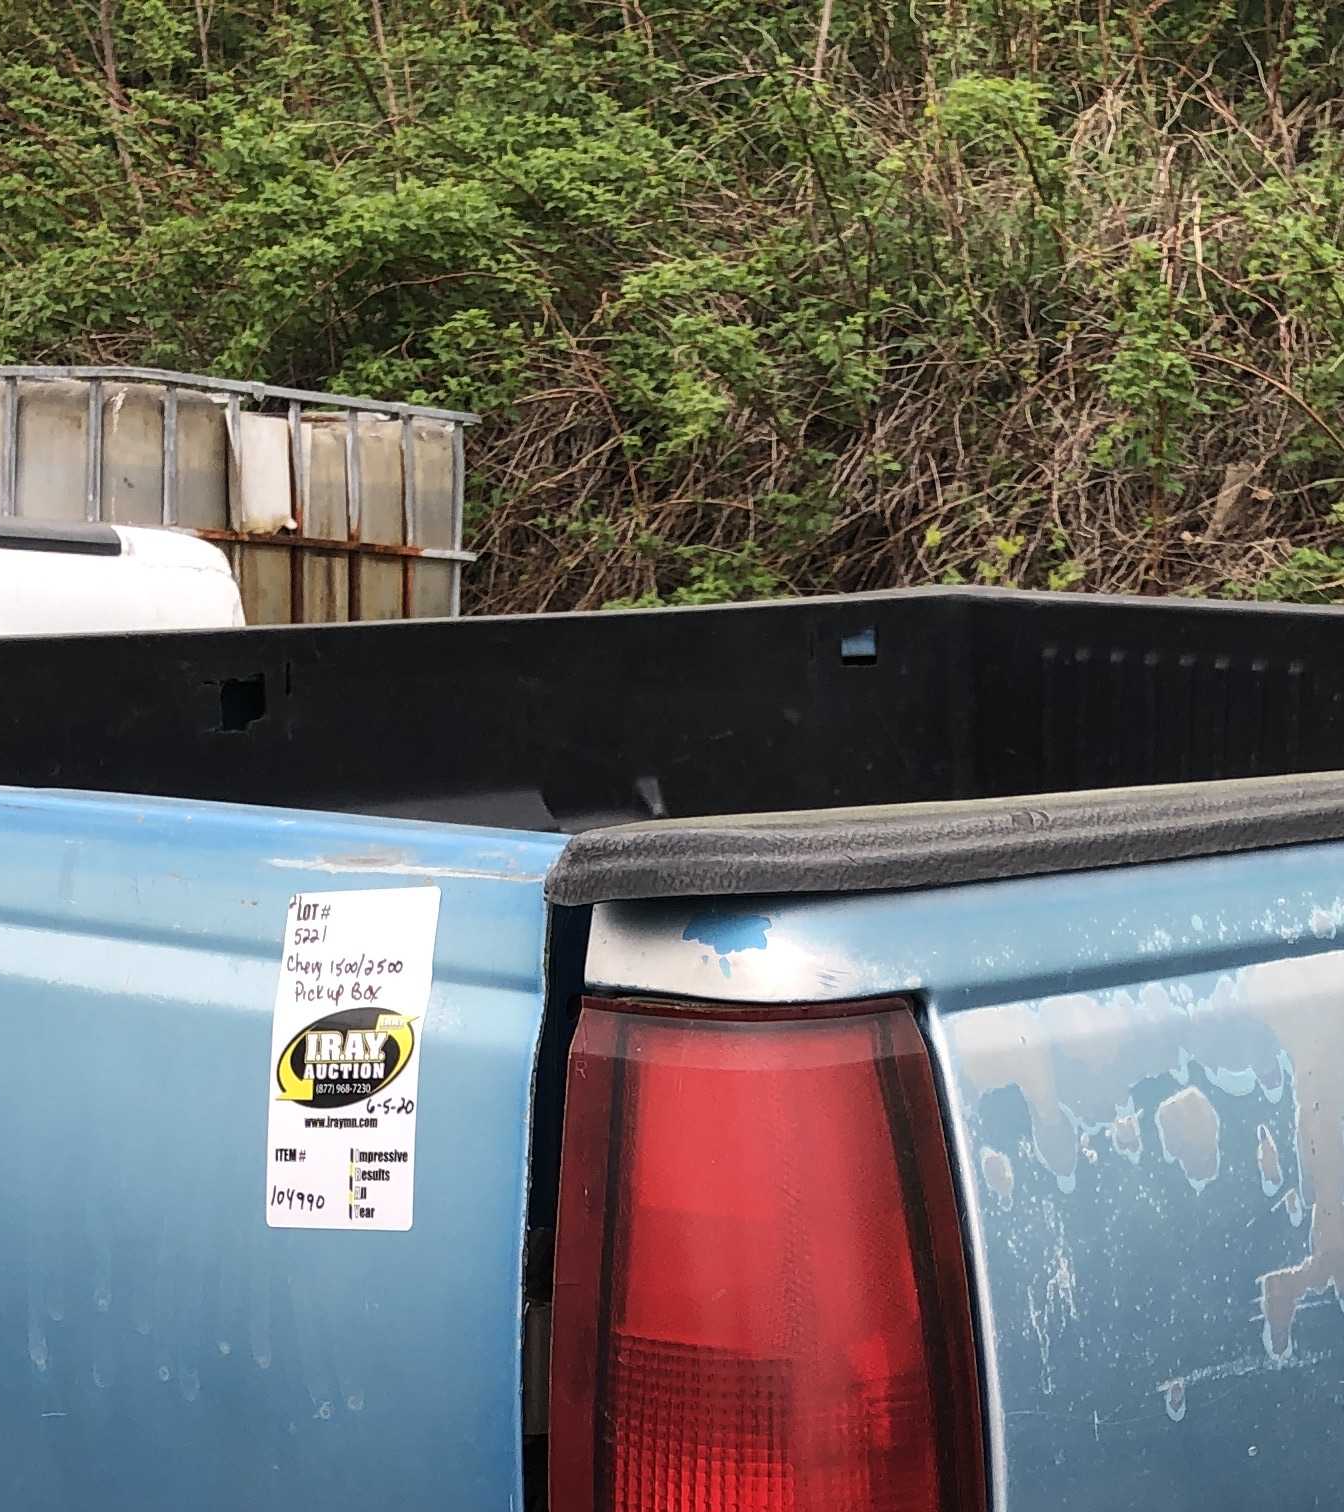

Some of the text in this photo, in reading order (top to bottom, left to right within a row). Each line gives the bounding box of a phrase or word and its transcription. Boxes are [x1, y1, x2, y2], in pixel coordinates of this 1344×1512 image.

[296, 902, 331, 921] LOT #
[294, 925, 327, 945] 5221
[286, 952, 403, 981] Chevy 1500/2500
[303, 1062, 385, 1080] AUCTION
[315, 1083, 371, 1094] (877) 968-7230
[366, 1097, 415, 1115] 6-5-20
[304, 1116, 378, 1129] www.iraymn.com
[275, 1148, 306, 1162] ITEM #
[355, 1148, 409, 1163] Impressive
[354, 1167, 391, 1182] Results
[270, 1185, 326, 1211] 104990
[353, 1204, 376, 1219] Year
